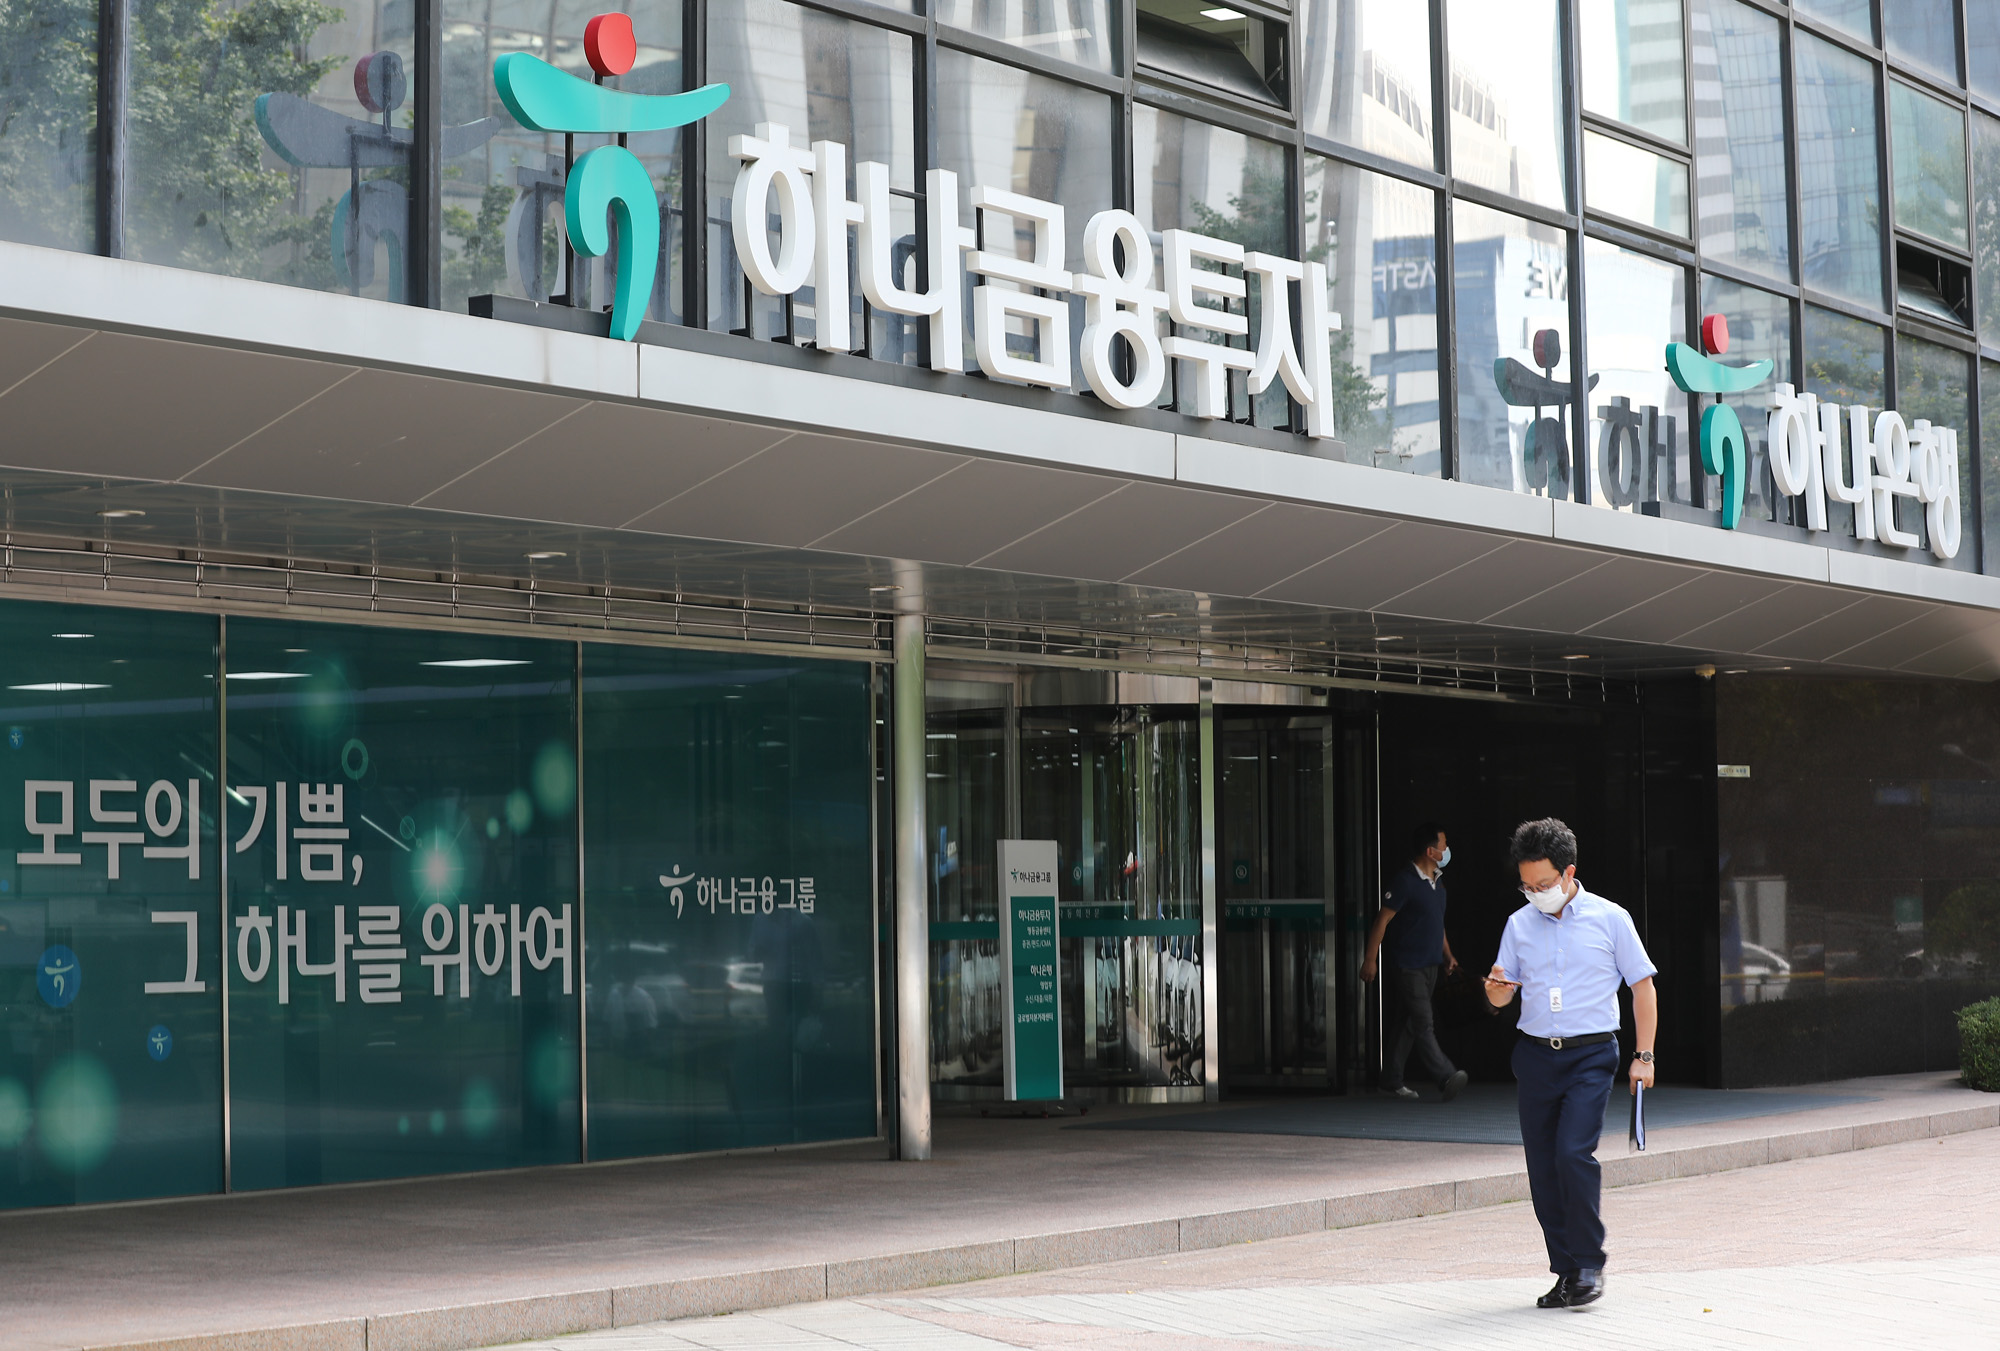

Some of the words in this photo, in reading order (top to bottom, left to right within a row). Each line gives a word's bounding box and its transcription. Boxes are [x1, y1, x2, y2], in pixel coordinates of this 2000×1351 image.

[728, 122, 1341, 439] 하나금융투자
[1766, 382, 1961, 559] 하나은행
[17, 778, 201, 880] 모두의
[235, 781, 364, 886] 기쁨,
[696, 876, 816, 914] 하나금융그룹
[1019, 871, 1051, 883] 하나금융그룹
[1018, 909, 1051, 922] 하나금융투자
[144, 911, 206, 994] 그
[235, 904, 406, 1004] 하나를
[421, 902, 572, 997] 위하여
[1030, 964, 1052, 976] 하나은행
